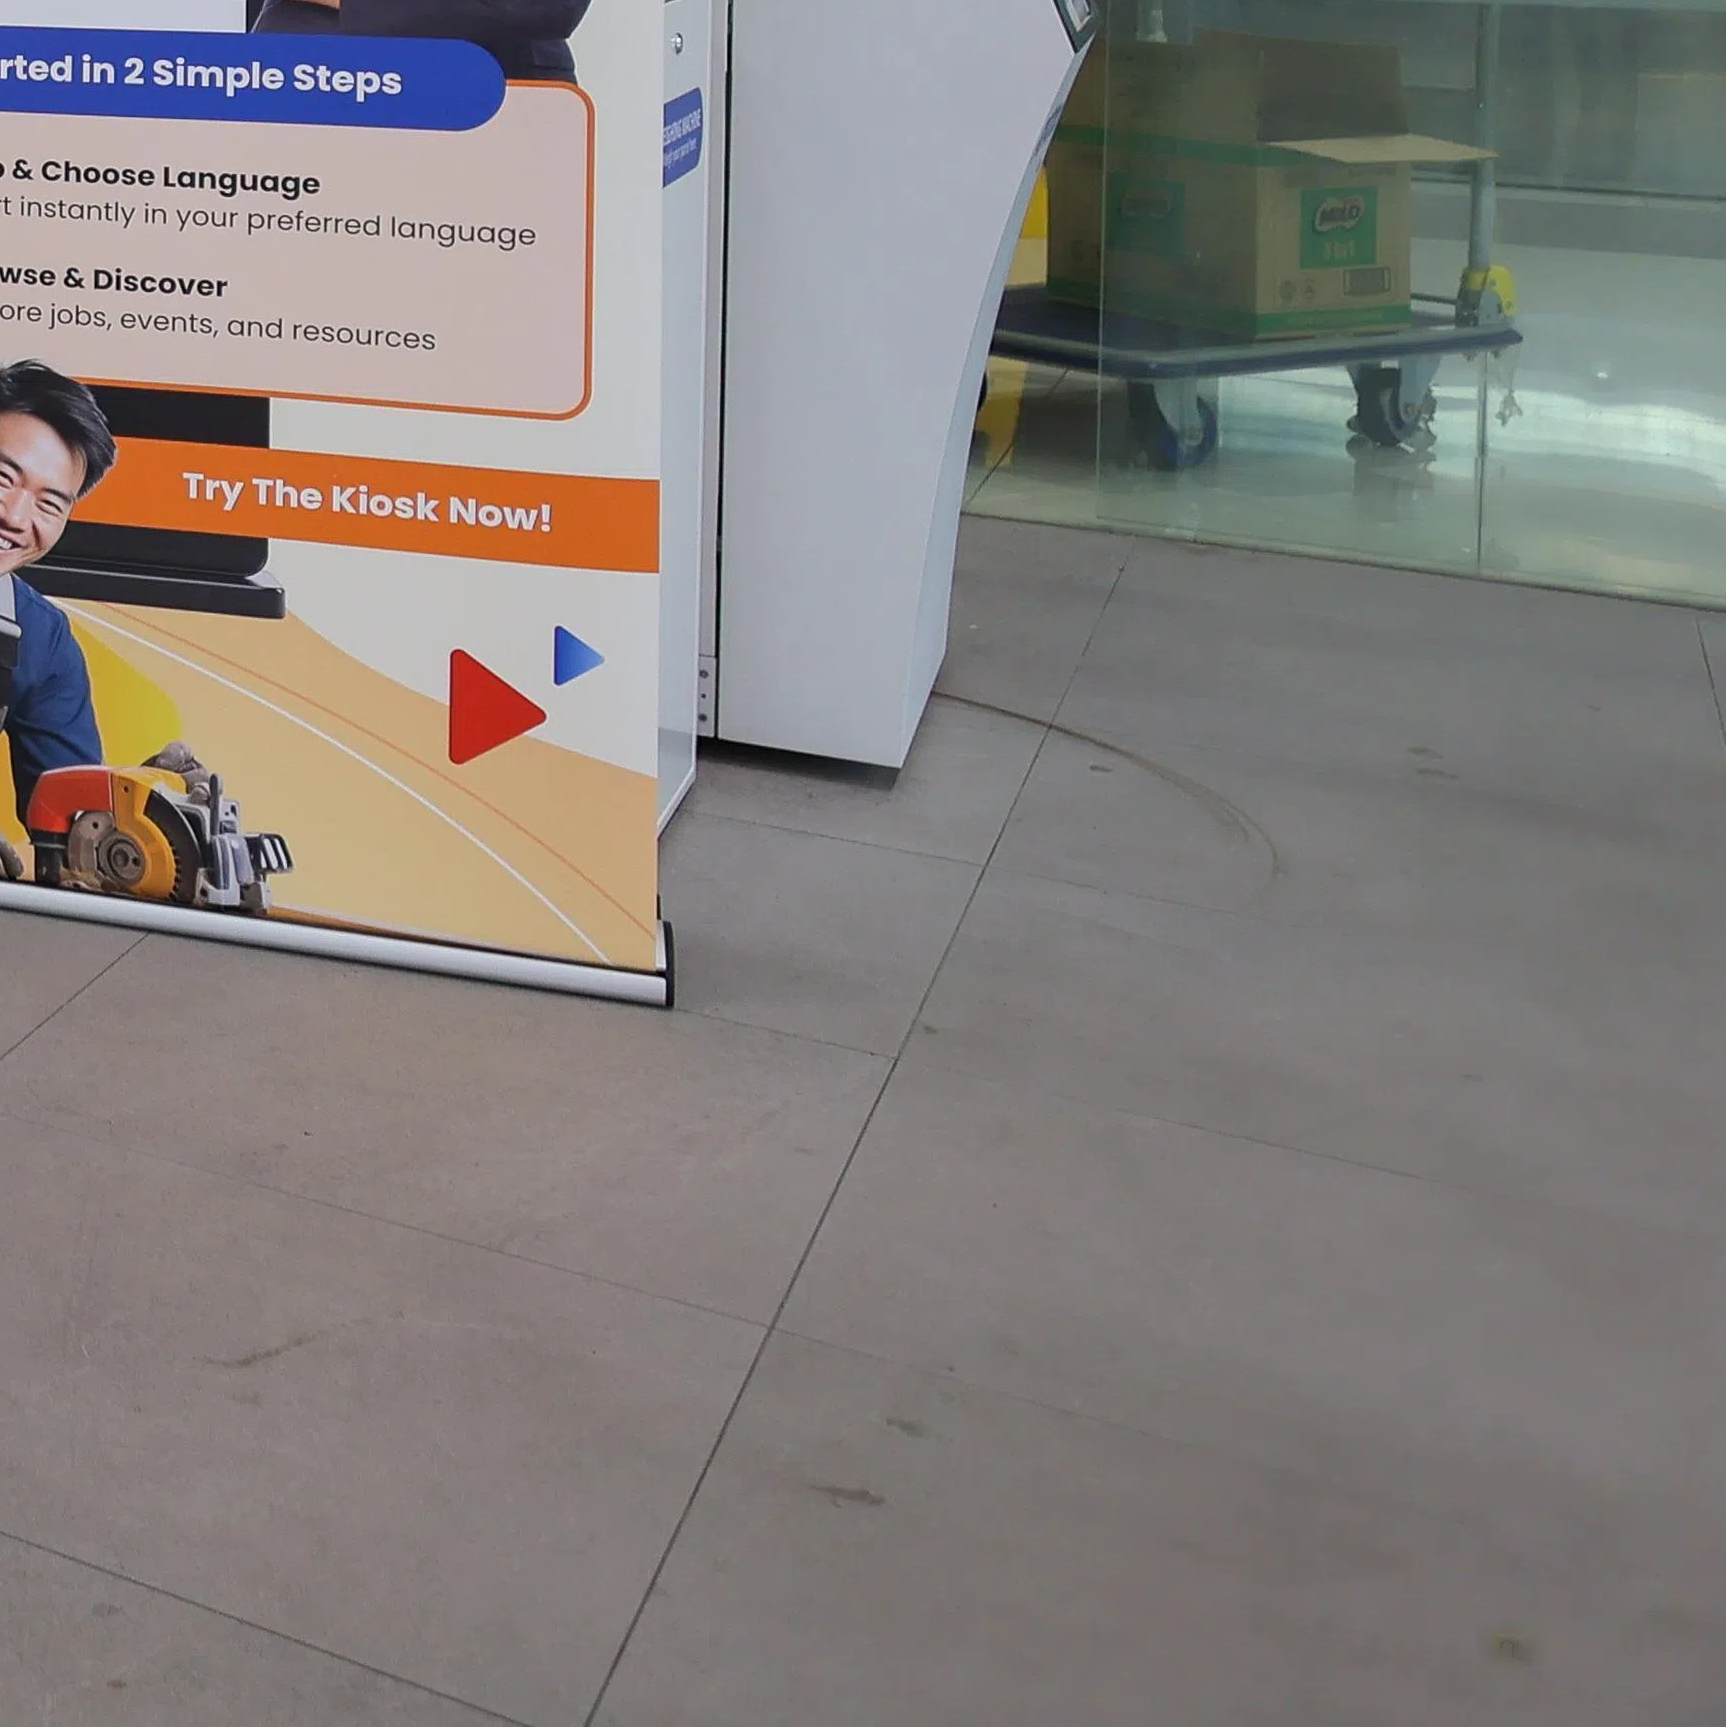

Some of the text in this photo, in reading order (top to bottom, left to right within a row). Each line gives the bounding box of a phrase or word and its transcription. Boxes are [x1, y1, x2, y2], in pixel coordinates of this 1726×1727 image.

[83, 54, 114, 83] in
[124, 58, 144, 84] 2
[153, 57, 284, 97] Simple
[294, 64, 401, 102] Steps
[12, 159, 33, 180] &
[42, 161, 155, 186] Choose
[164, 167, 320, 200] Language
[21, 196, 135, 228] instantly
[145, 203, 166, 224] in
[176, 210, 238, 231] your
[248, 211, 380, 236] preferred
[392, 216, 535, 251] language
[64, 268, 85, 288] &
[94, 268, 227, 297] Discover
[49, 303, 111, 330] jobs,
[121, 314, 218, 338] events,
[228, 318, 282, 338] and
[294, 325, 435, 350] resources
[183, 472, 552, 532] Try The Kiosk Now!
